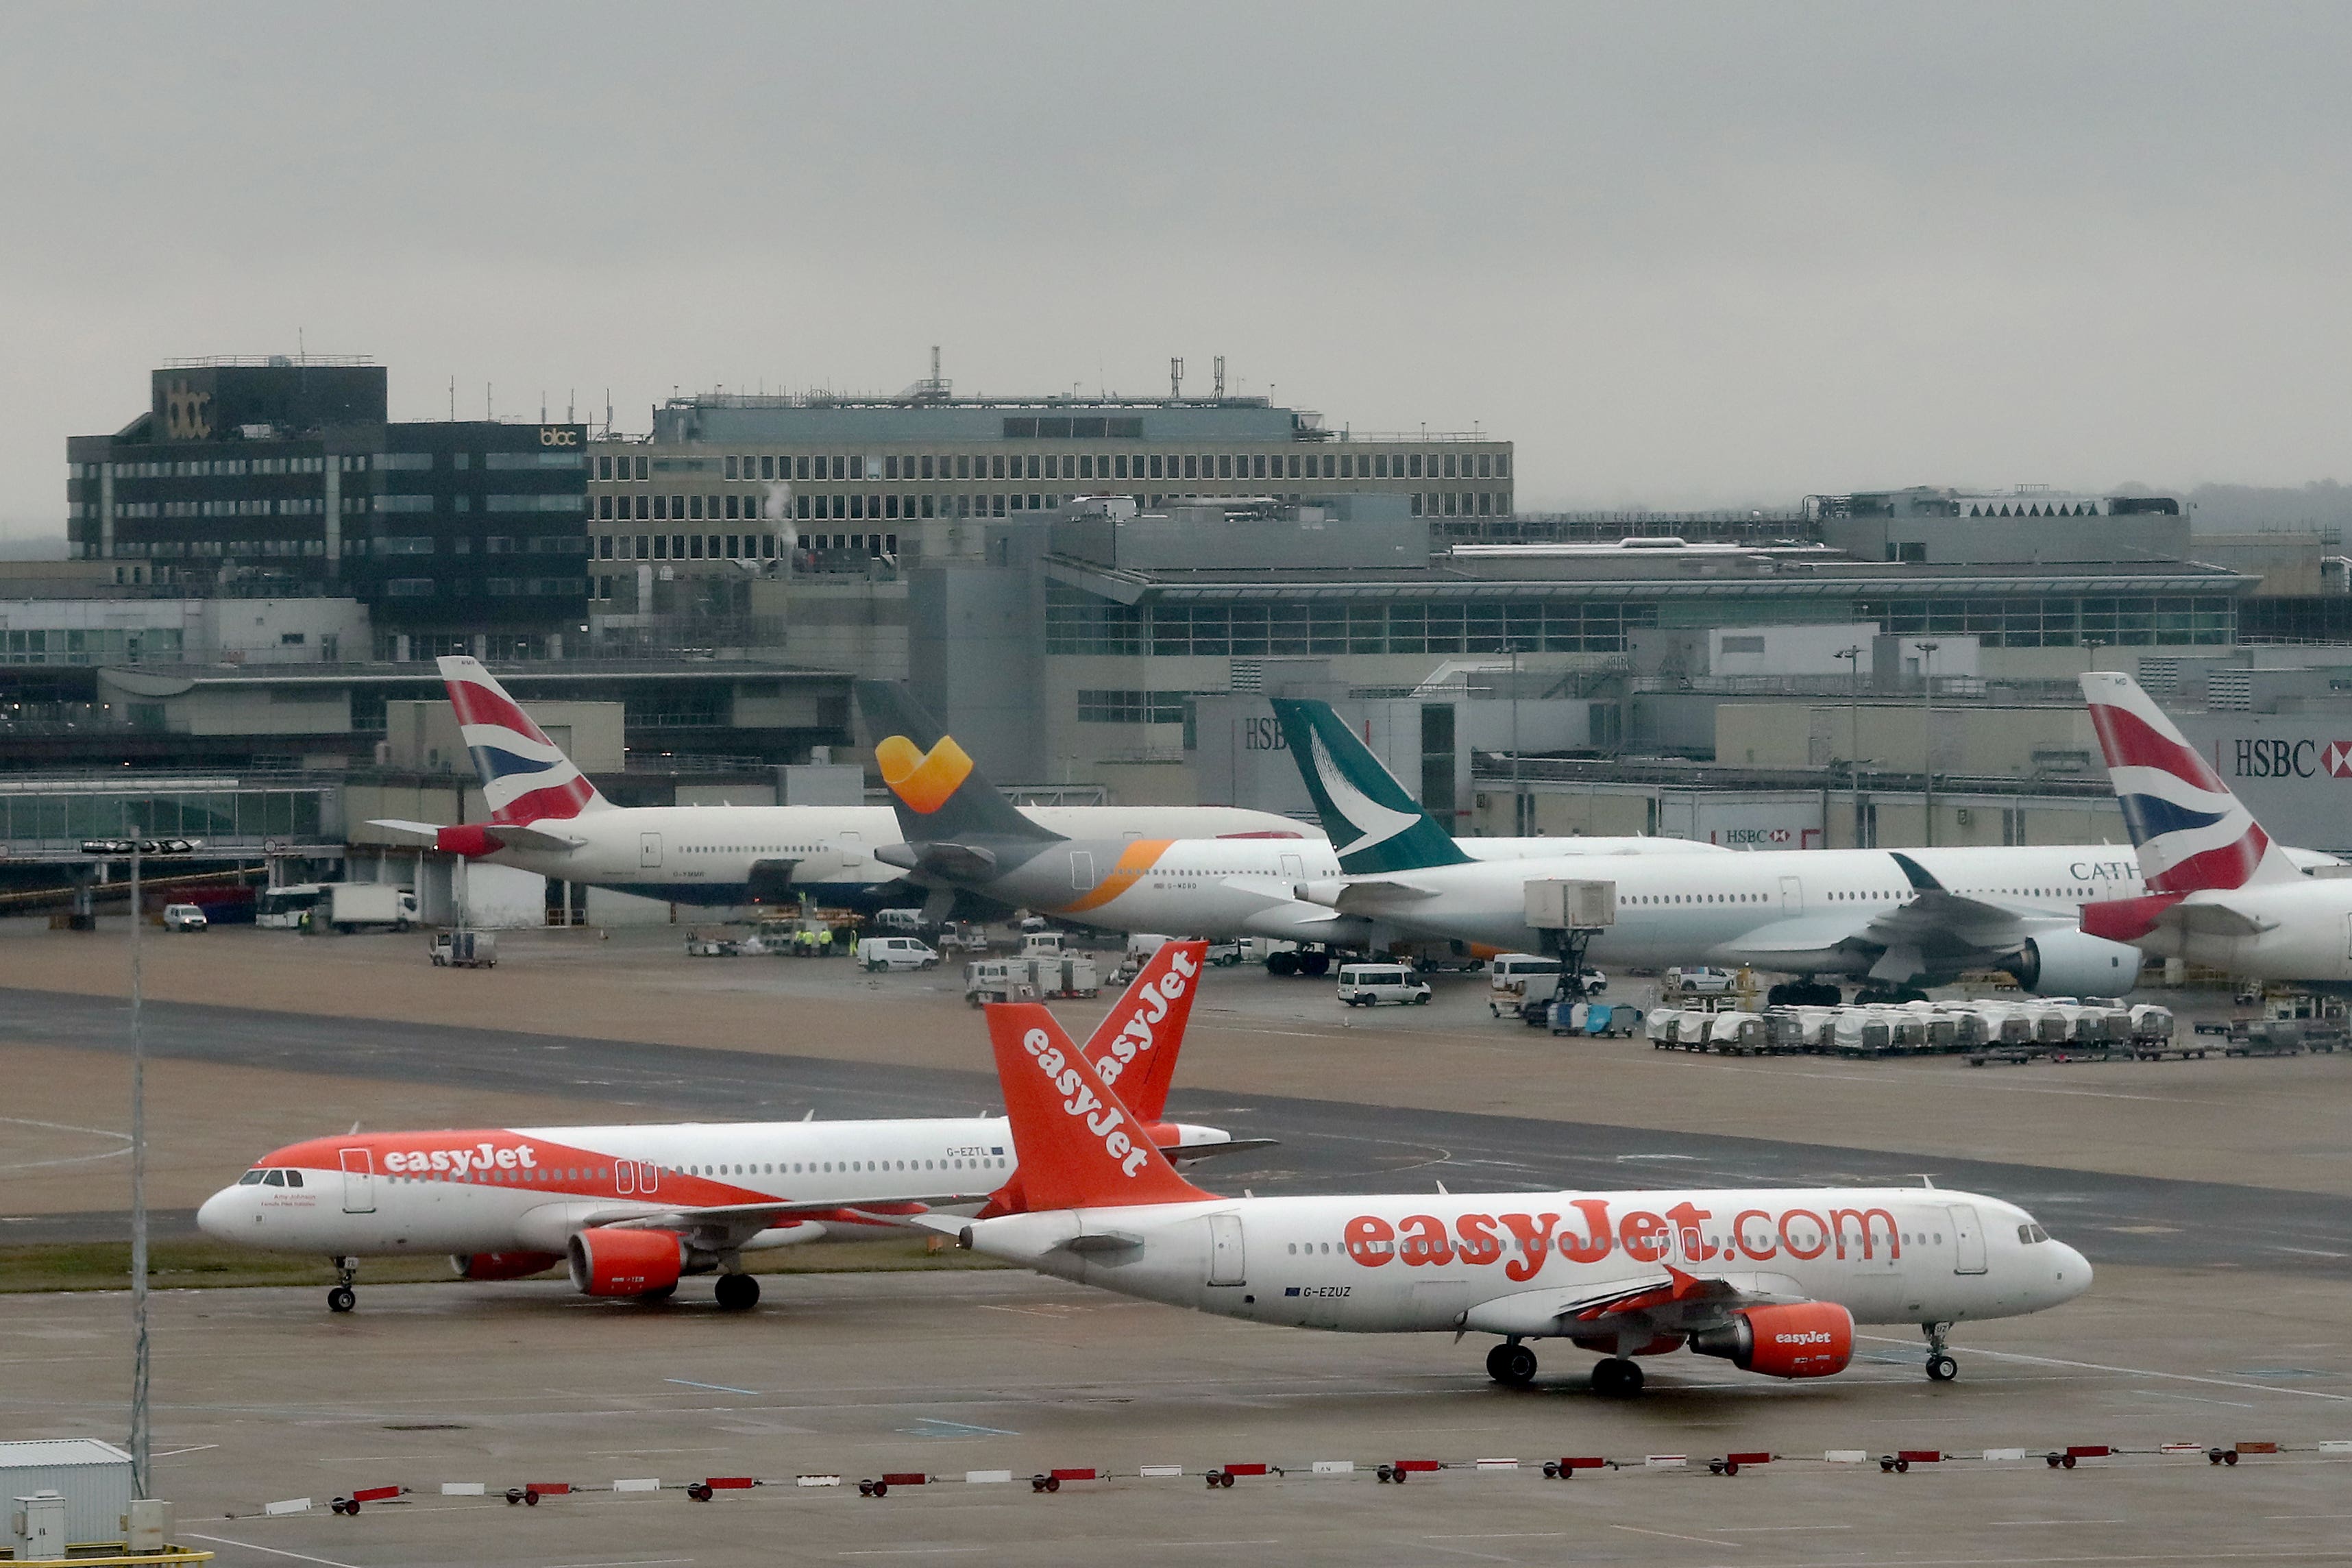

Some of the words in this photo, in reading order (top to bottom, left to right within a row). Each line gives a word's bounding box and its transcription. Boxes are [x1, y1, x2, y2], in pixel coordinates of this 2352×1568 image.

[540, 427, 577, 446] bloc
[2235, 739, 2316, 779] HSBC
[1726, 829, 1767, 843] HSBC
[1023, 1028, 1148, 1178] easyJet
[384, 1143, 537, 1176] easyJet
[946, 1147, 988, 1157] G-EZTL
[1344, 1199, 1901, 1282] easyJet.com
[1303, 1287, 1351, 1297] G-EZUZ
[1775, 1330, 1831, 1345] easyJet
